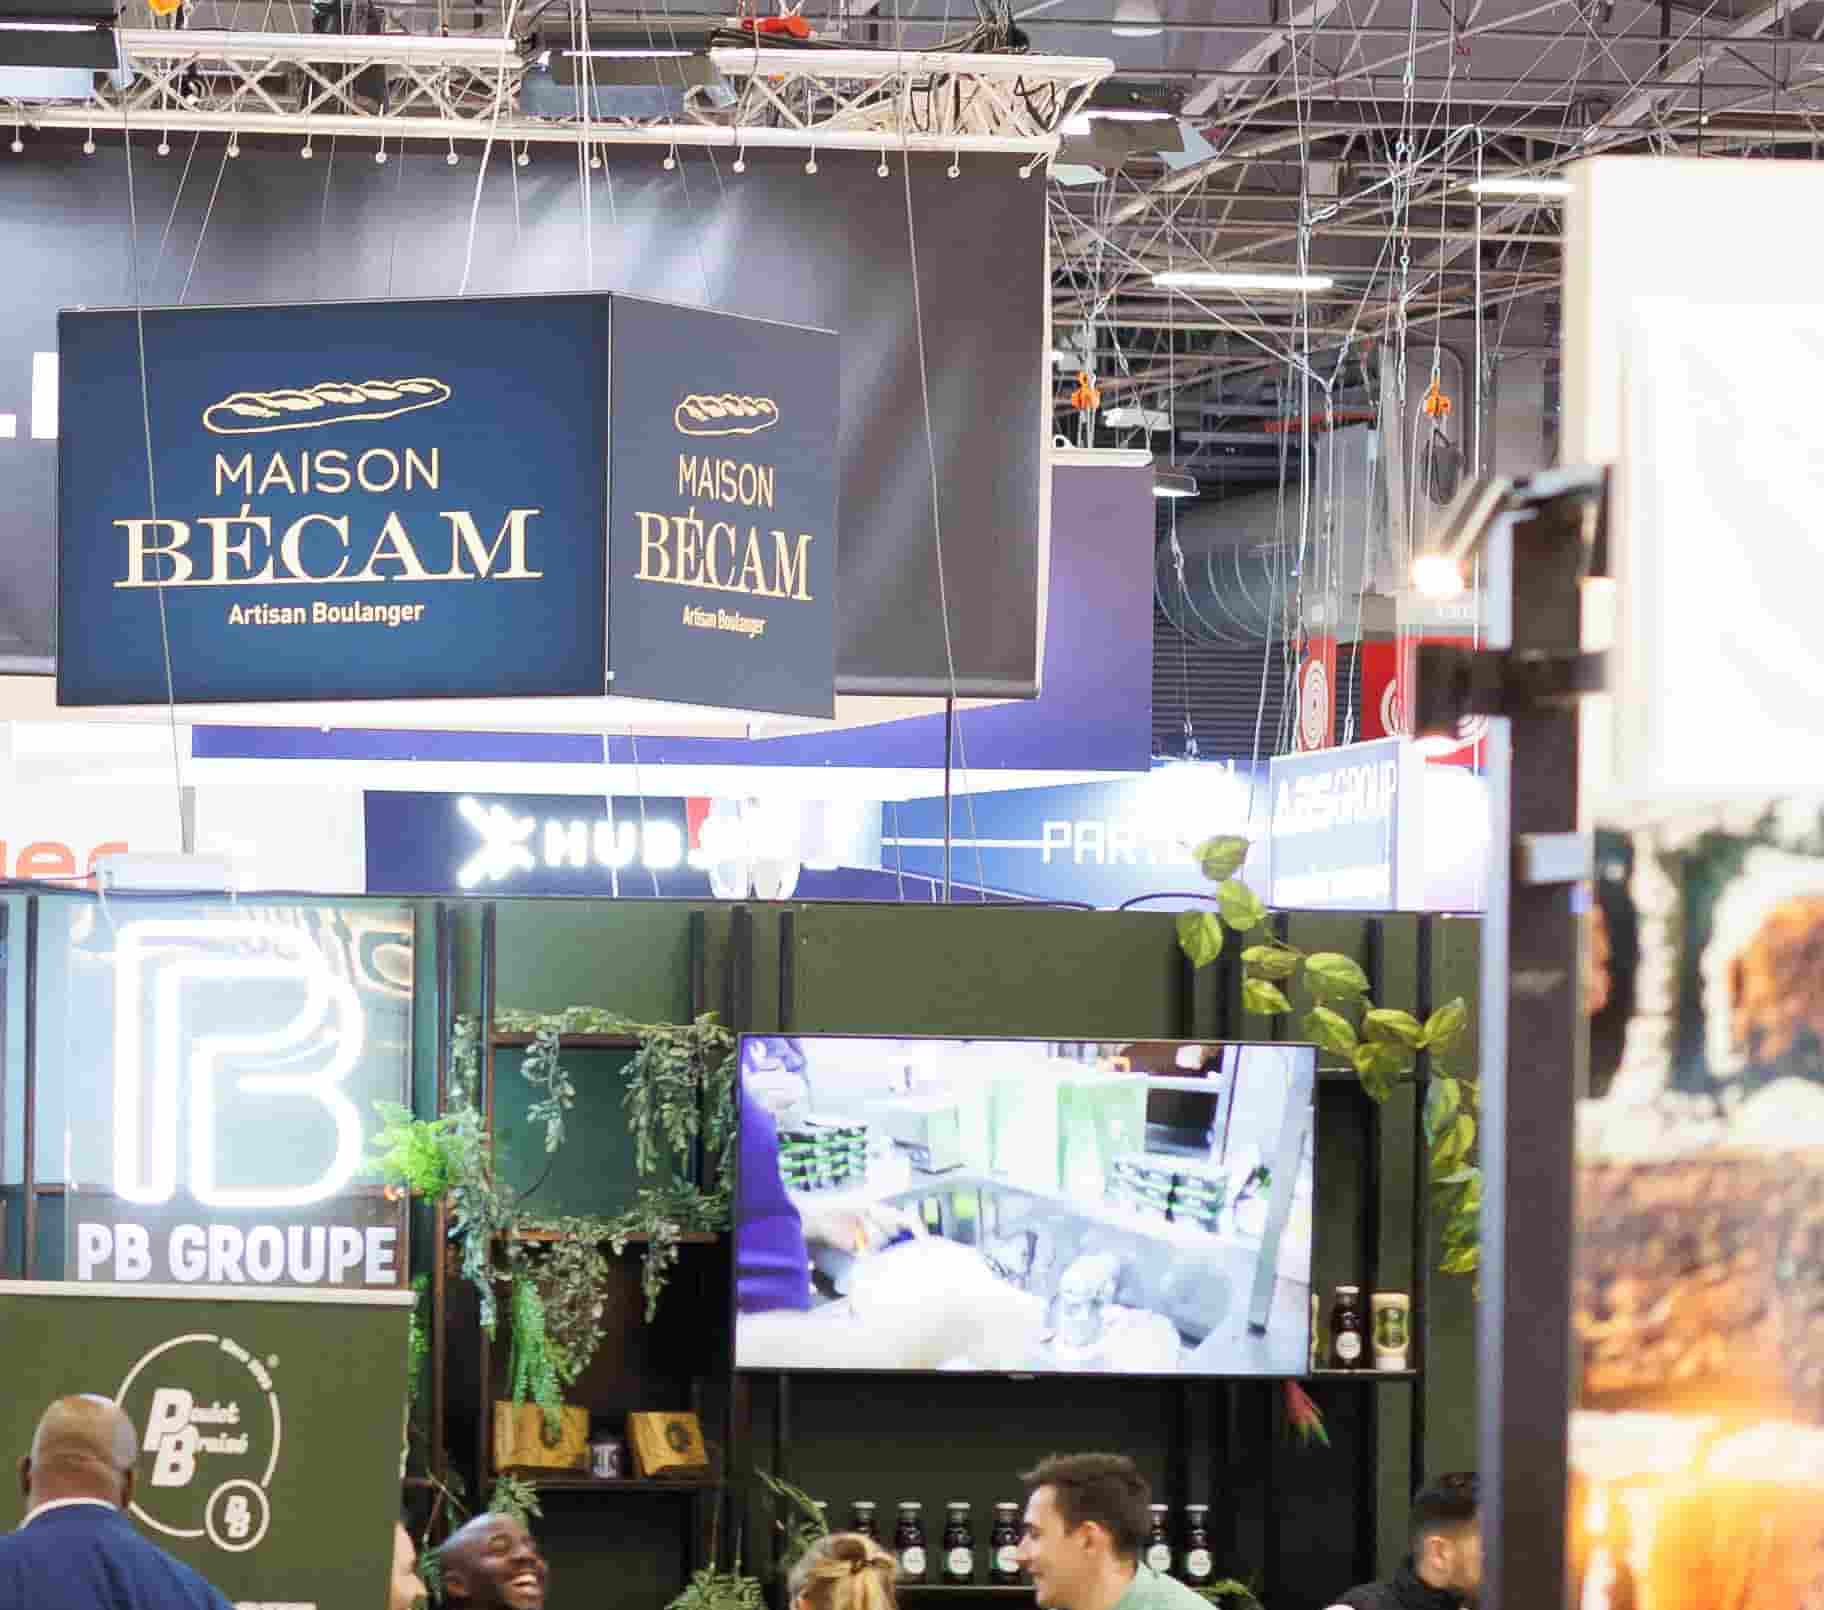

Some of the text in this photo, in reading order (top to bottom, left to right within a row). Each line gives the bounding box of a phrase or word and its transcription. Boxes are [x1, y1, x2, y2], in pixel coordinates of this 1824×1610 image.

[215, 447, 440, 496] MAISON
[678, 453, 774, 508] MAISON
[113, 503, 545, 588] BÉCAM
[632, 505, 814, 601] BÉCAM
[228, 600, 425, 627] Artisan Boulanger
[682, 605, 768, 638] Artisan Boulanger
[77, 1223, 399, 1285] PB GROUPE
